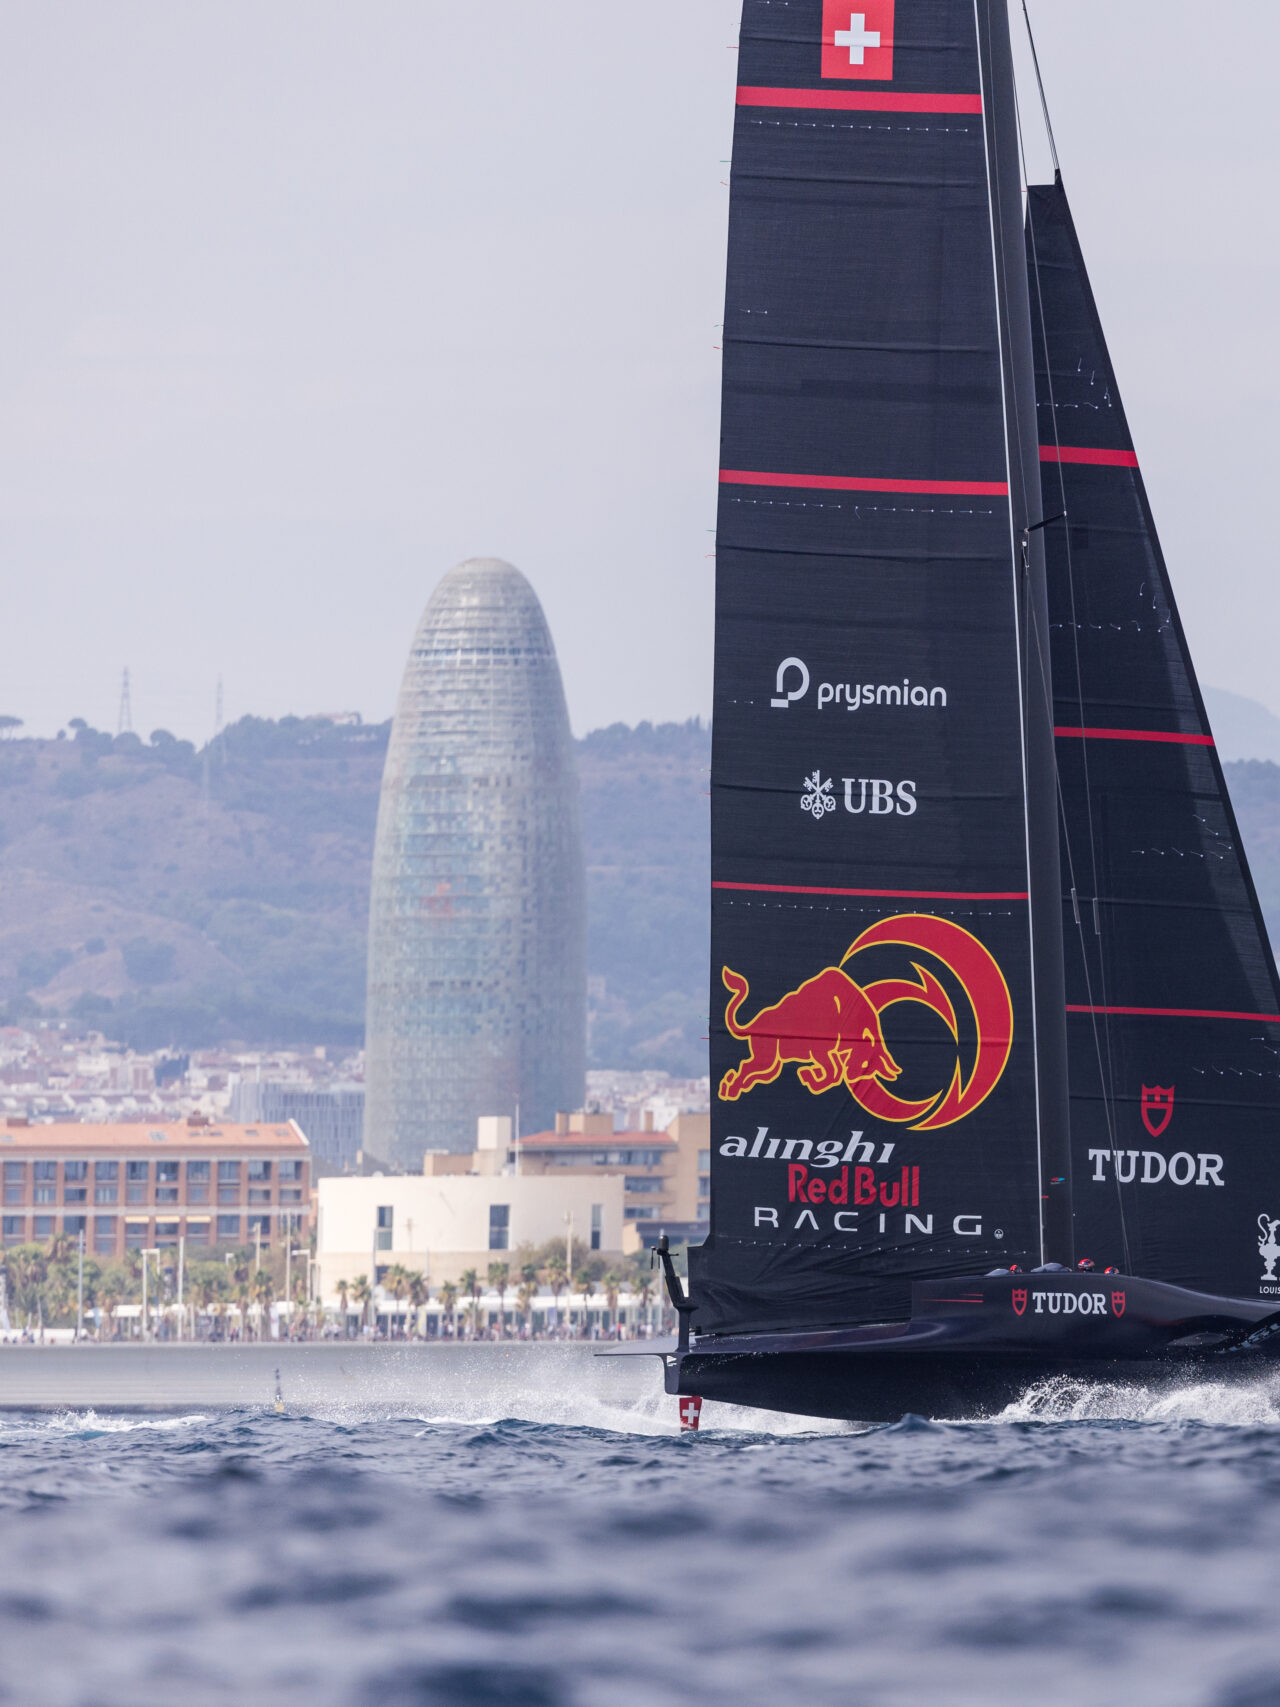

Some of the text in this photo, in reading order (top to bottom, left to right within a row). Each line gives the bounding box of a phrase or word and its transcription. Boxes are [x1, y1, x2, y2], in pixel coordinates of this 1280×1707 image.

[817, 678, 947, 711] prysmian
[841, 777, 917, 816] UBS
[719, 1126, 896, 1168] alinghi
[1088, 1148, 1225, 1187] TUDOR
[754, 1206, 983, 1236] RACING
[1032, 1292, 1108, 1315] TUDOR
